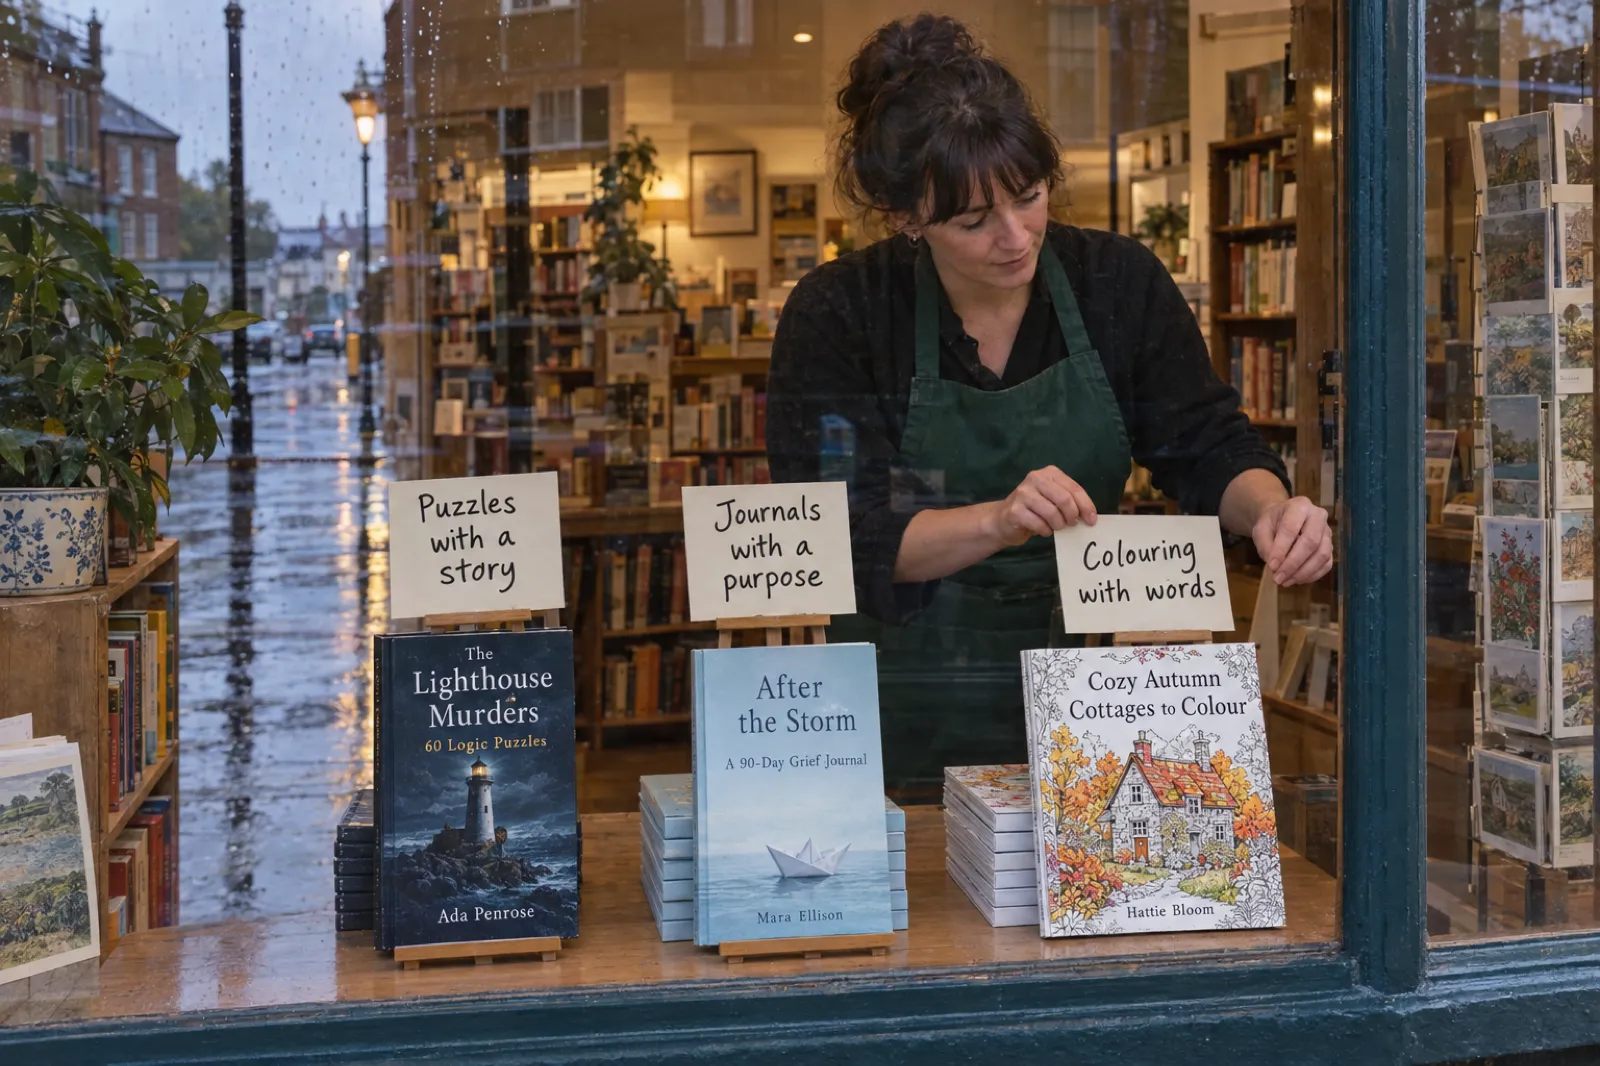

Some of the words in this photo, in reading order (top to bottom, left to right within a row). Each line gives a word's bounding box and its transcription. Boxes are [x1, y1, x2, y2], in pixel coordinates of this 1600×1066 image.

[418, 488, 517, 524] Puzzles
[715, 494, 822, 532] Journals
[431, 525, 483, 553] with
[499, 531, 515, 546] a
[731, 533, 783, 561] with
[796, 540, 813, 556] a
[1083, 540, 1197, 574] Colouring
[440, 557, 516, 593] story
[724, 569, 823, 602] purpose
[1079, 579, 1130, 603] with
[1145, 574, 1216, 602] words
[464, 646, 493, 661] The
[412, 665, 553, 700] Lighthouse
[756, 674, 822, 699] After
[1088, 672, 1137, 695] Cozy
[1145, 670, 1221, 688] Autumn
[429, 700, 540, 728] Murders
[737, 708, 777, 734] the
[787, 708, 858, 733] Storm
[1069, 700, 1155, 724] Cottages
[1161, 704, 1175, 715] to
[1181, 695, 1248, 716] Colour
[425, 740, 441, 752] 60
[448, 738, 487, 754] Logic
[494, 735, 546, 749] Puzzles
[725, 757, 736, 770] A
[740, 757, 784, 772] 90-Day
[790, 754, 821, 767] Grief
[824, 752, 868, 770] Journal
[438, 908, 468, 923] Ada
[475, 907, 534, 920] Penrose
[758, 912, 791, 924] Mara
[800, 909, 842, 921] Ellison
[1127, 906, 1166, 918] Hattie
[1173, 904, 1214, 915] Bloom
